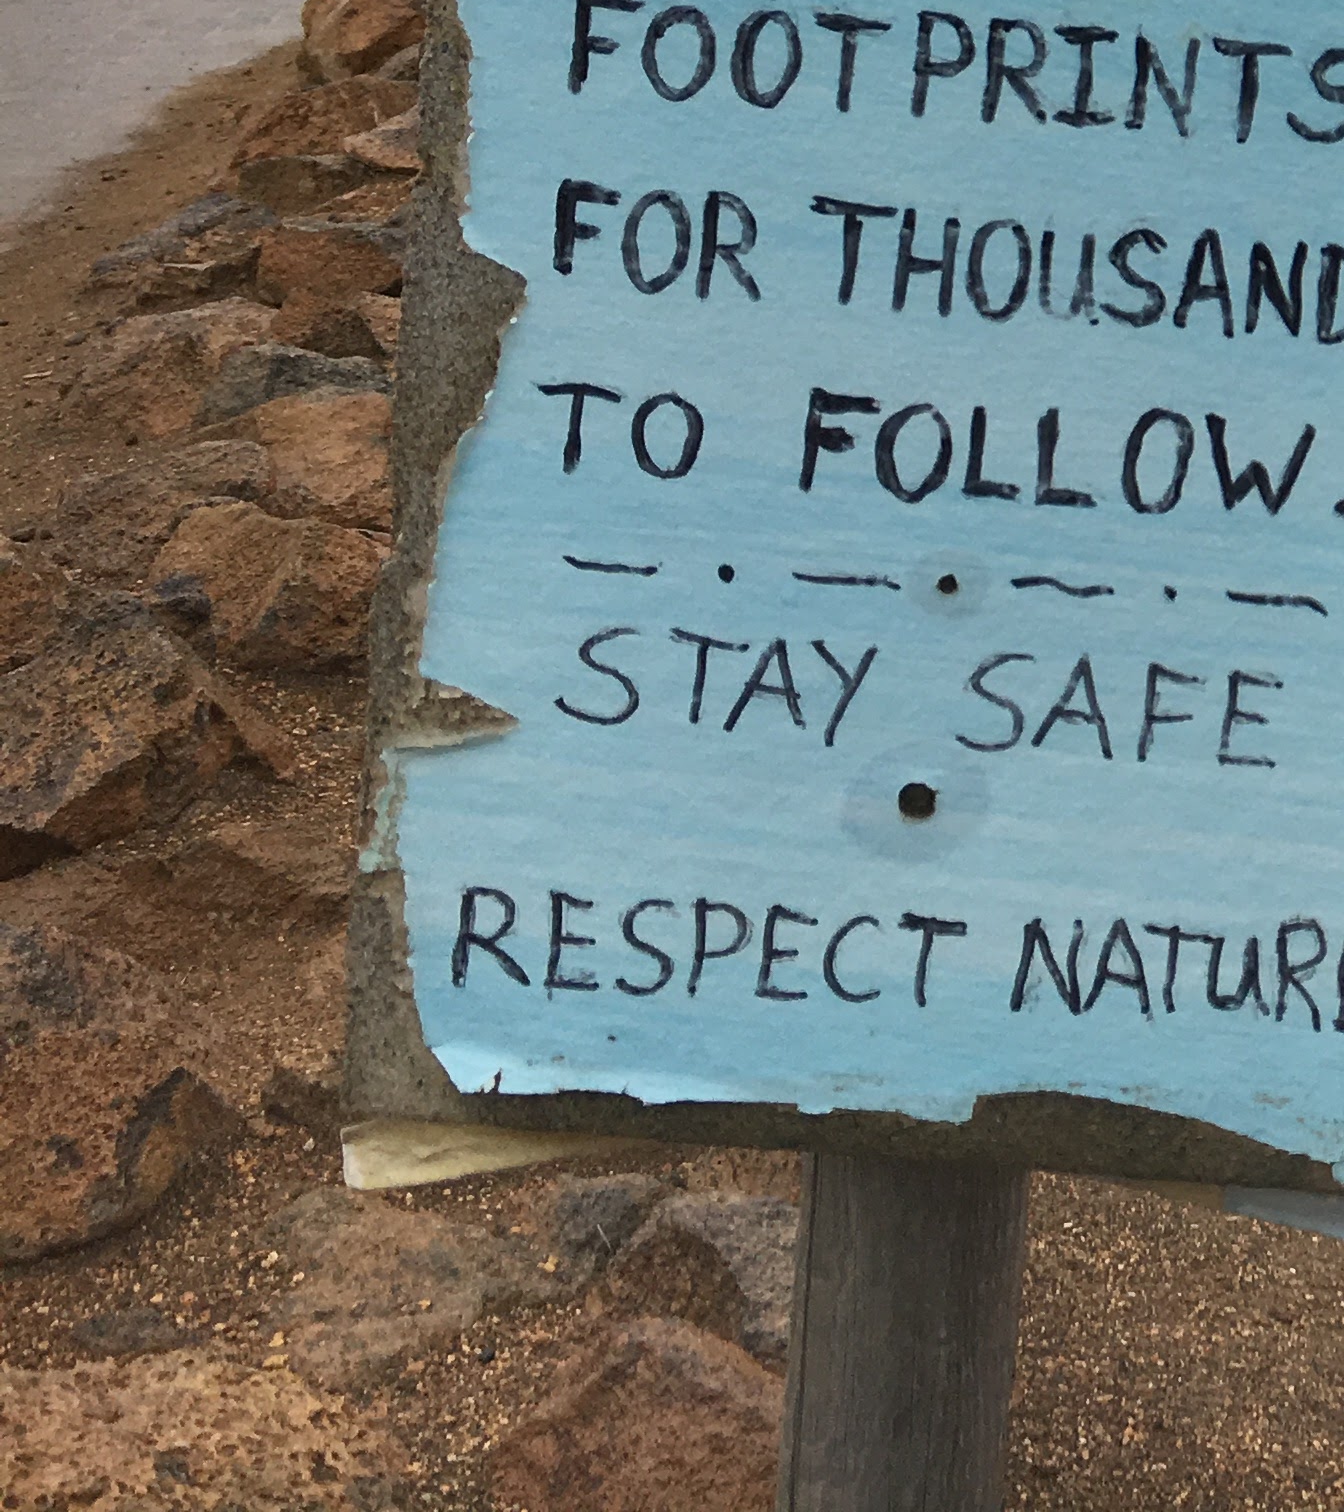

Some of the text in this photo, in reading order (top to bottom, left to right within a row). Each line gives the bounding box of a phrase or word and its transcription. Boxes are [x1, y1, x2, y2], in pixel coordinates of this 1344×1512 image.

[553, 178, 761, 301] FOR
[539, 381, 705, 479] TO
[554, 626, 1285, 769] STAY SAFE
[450, 885, 968, 1007] RESPECT
